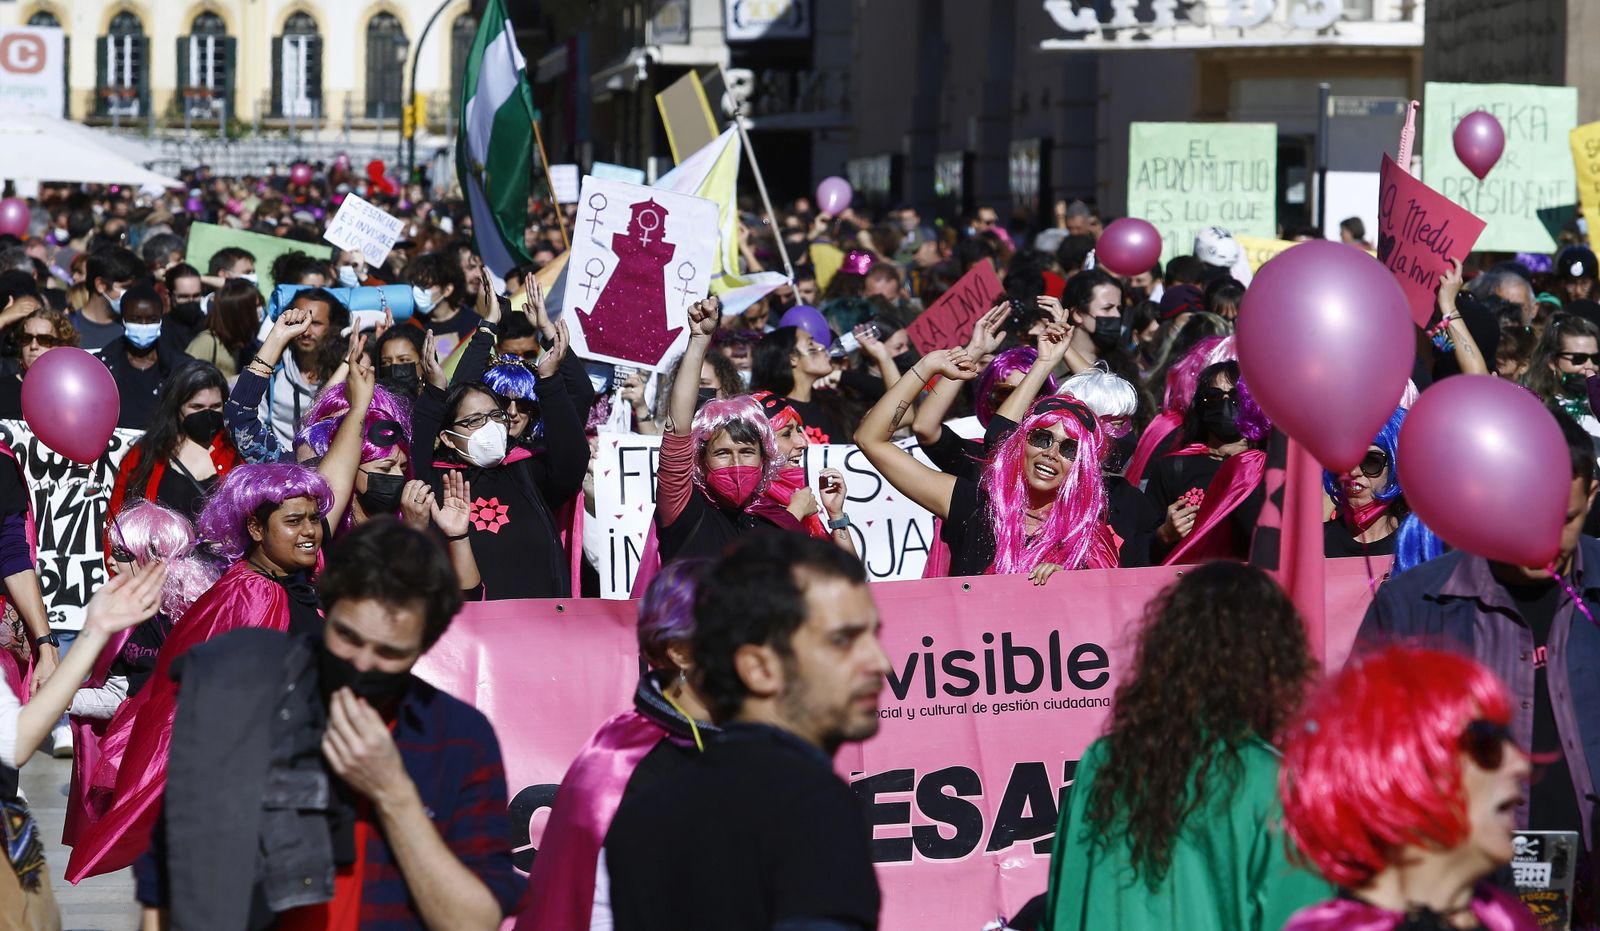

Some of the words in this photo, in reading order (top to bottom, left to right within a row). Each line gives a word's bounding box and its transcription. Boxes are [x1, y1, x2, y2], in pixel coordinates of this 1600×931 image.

[1189, 139, 1216, 158] EL
[1146, 199, 1174, 223] ES
[1185, 200, 1209, 222] LO
[1220, 200, 1264, 222] QUE
[907, 708, 915, 720] y
[920, 703, 967, 717] cultural
[972, 702, 988, 713] de
[993, 699, 1039, 715] gestión
[1043, 697, 1110, 710] ciudadana
